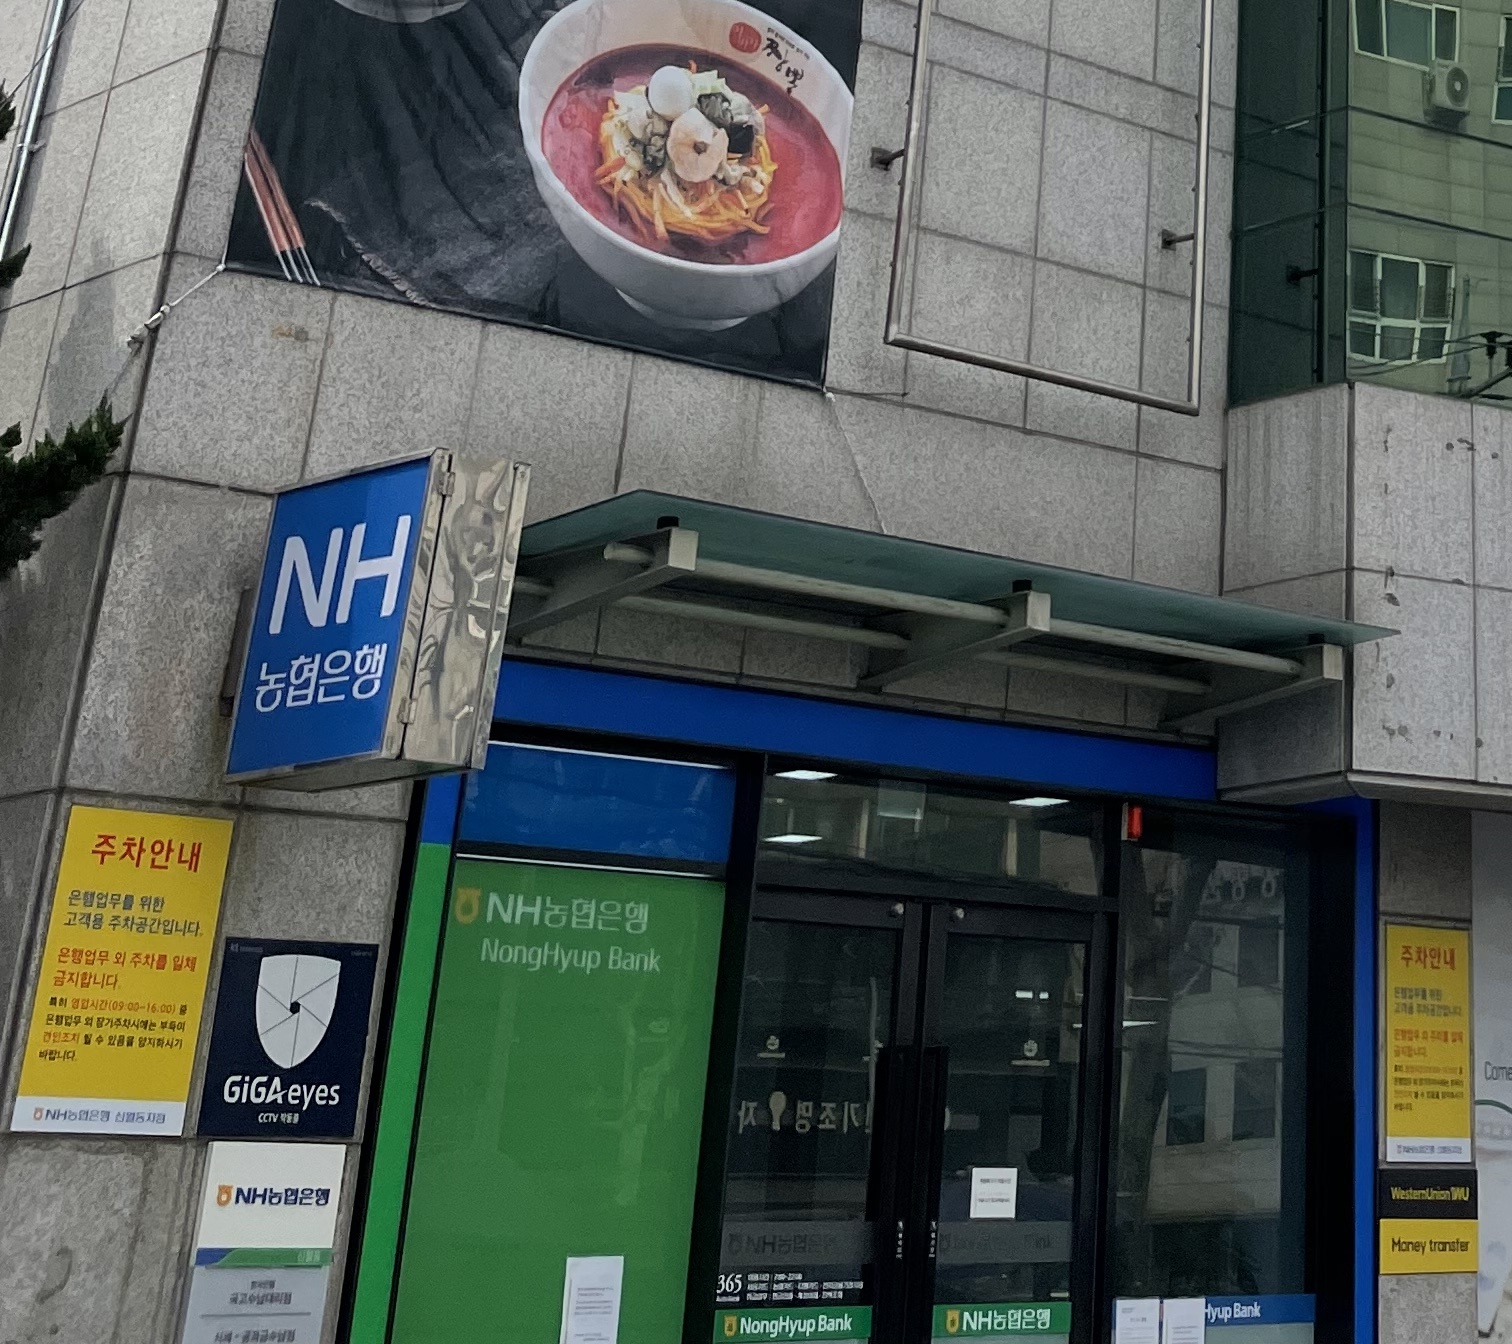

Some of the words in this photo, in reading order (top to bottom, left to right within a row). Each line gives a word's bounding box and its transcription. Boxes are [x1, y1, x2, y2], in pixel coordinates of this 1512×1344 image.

[268, 515, 412, 635] NH
[255, 643, 388, 713] 농협은행
[91, 834, 203, 873] 주차안내
[140, 895, 166, 913] 위한
[486, 891, 649, 934] NH농협은행
[57, 946, 109, 966] 은행업무
[114, 951, 126, 968] 외
[130, 952, 167, 971] 주차를
[481, 937, 601, 975] NongHyup
[608, 945, 661, 973] Bank
[1401, 945, 1456, 971] 주차안내
[258, 1113, 278, 1123] CCTV
[235, 1187, 331, 1206] NH농협은행
[1391, 1237, 1427, 1256] Money
[1429, 1238, 1470, 1252] transfer
[716, 1273, 743, 1294] 365
[962, 1308, 1051, 1331] NH농협은행
[1234, 1301, 1261, 1318] Bank
[740, 1315, 816, 1338] NongHyup
[817, 1313, 853, 1332] Bank
